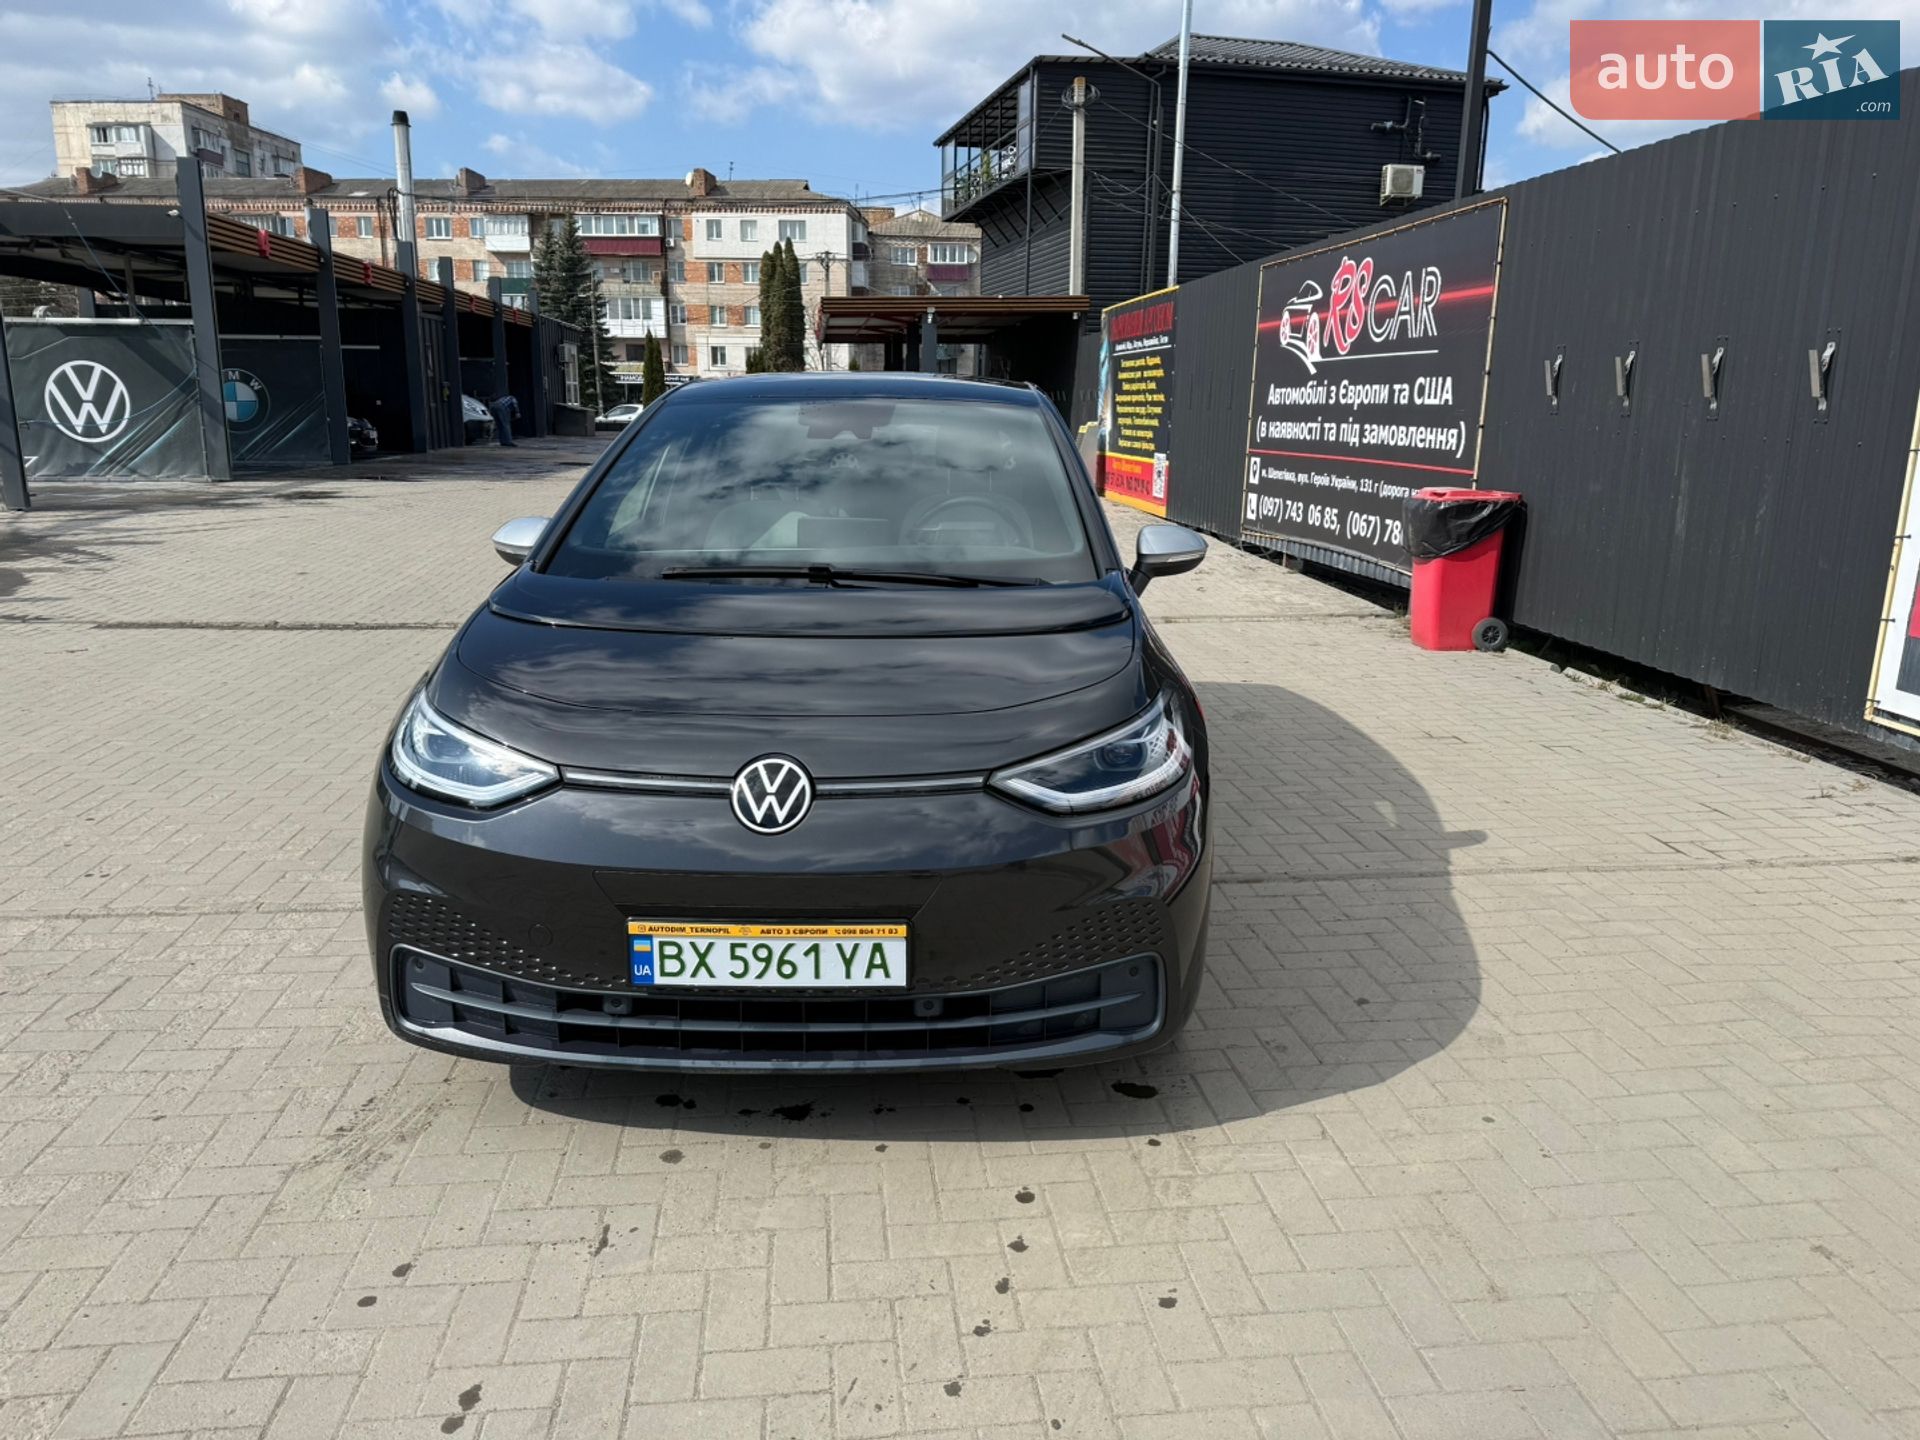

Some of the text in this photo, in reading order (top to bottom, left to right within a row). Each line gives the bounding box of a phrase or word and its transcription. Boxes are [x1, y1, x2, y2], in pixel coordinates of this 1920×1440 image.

[1267, 376, 1453, 411] Автомобілі з Європи та США
[1256, 415, 1466, 459] (в наявності та під замовлення)
[1360, 478, 1373, 493] 131
[1379, 480, 1409, 499] (дорога
[1259, 495, 1283, 523] (097)
[1285, 500, 1304, 522] 743
[1307, 504, 1322, 526] 06
[1323, 507, 1340, 535] 85,
[1346, 510, 1380, 546] (067)
[760, 928, 784, 936] АВТО
[792, 928, 828, 936] ЄВРОПИ
[634, 964, 652, 976] UA
[658, 941, 891, 980] BX 5961 YA
